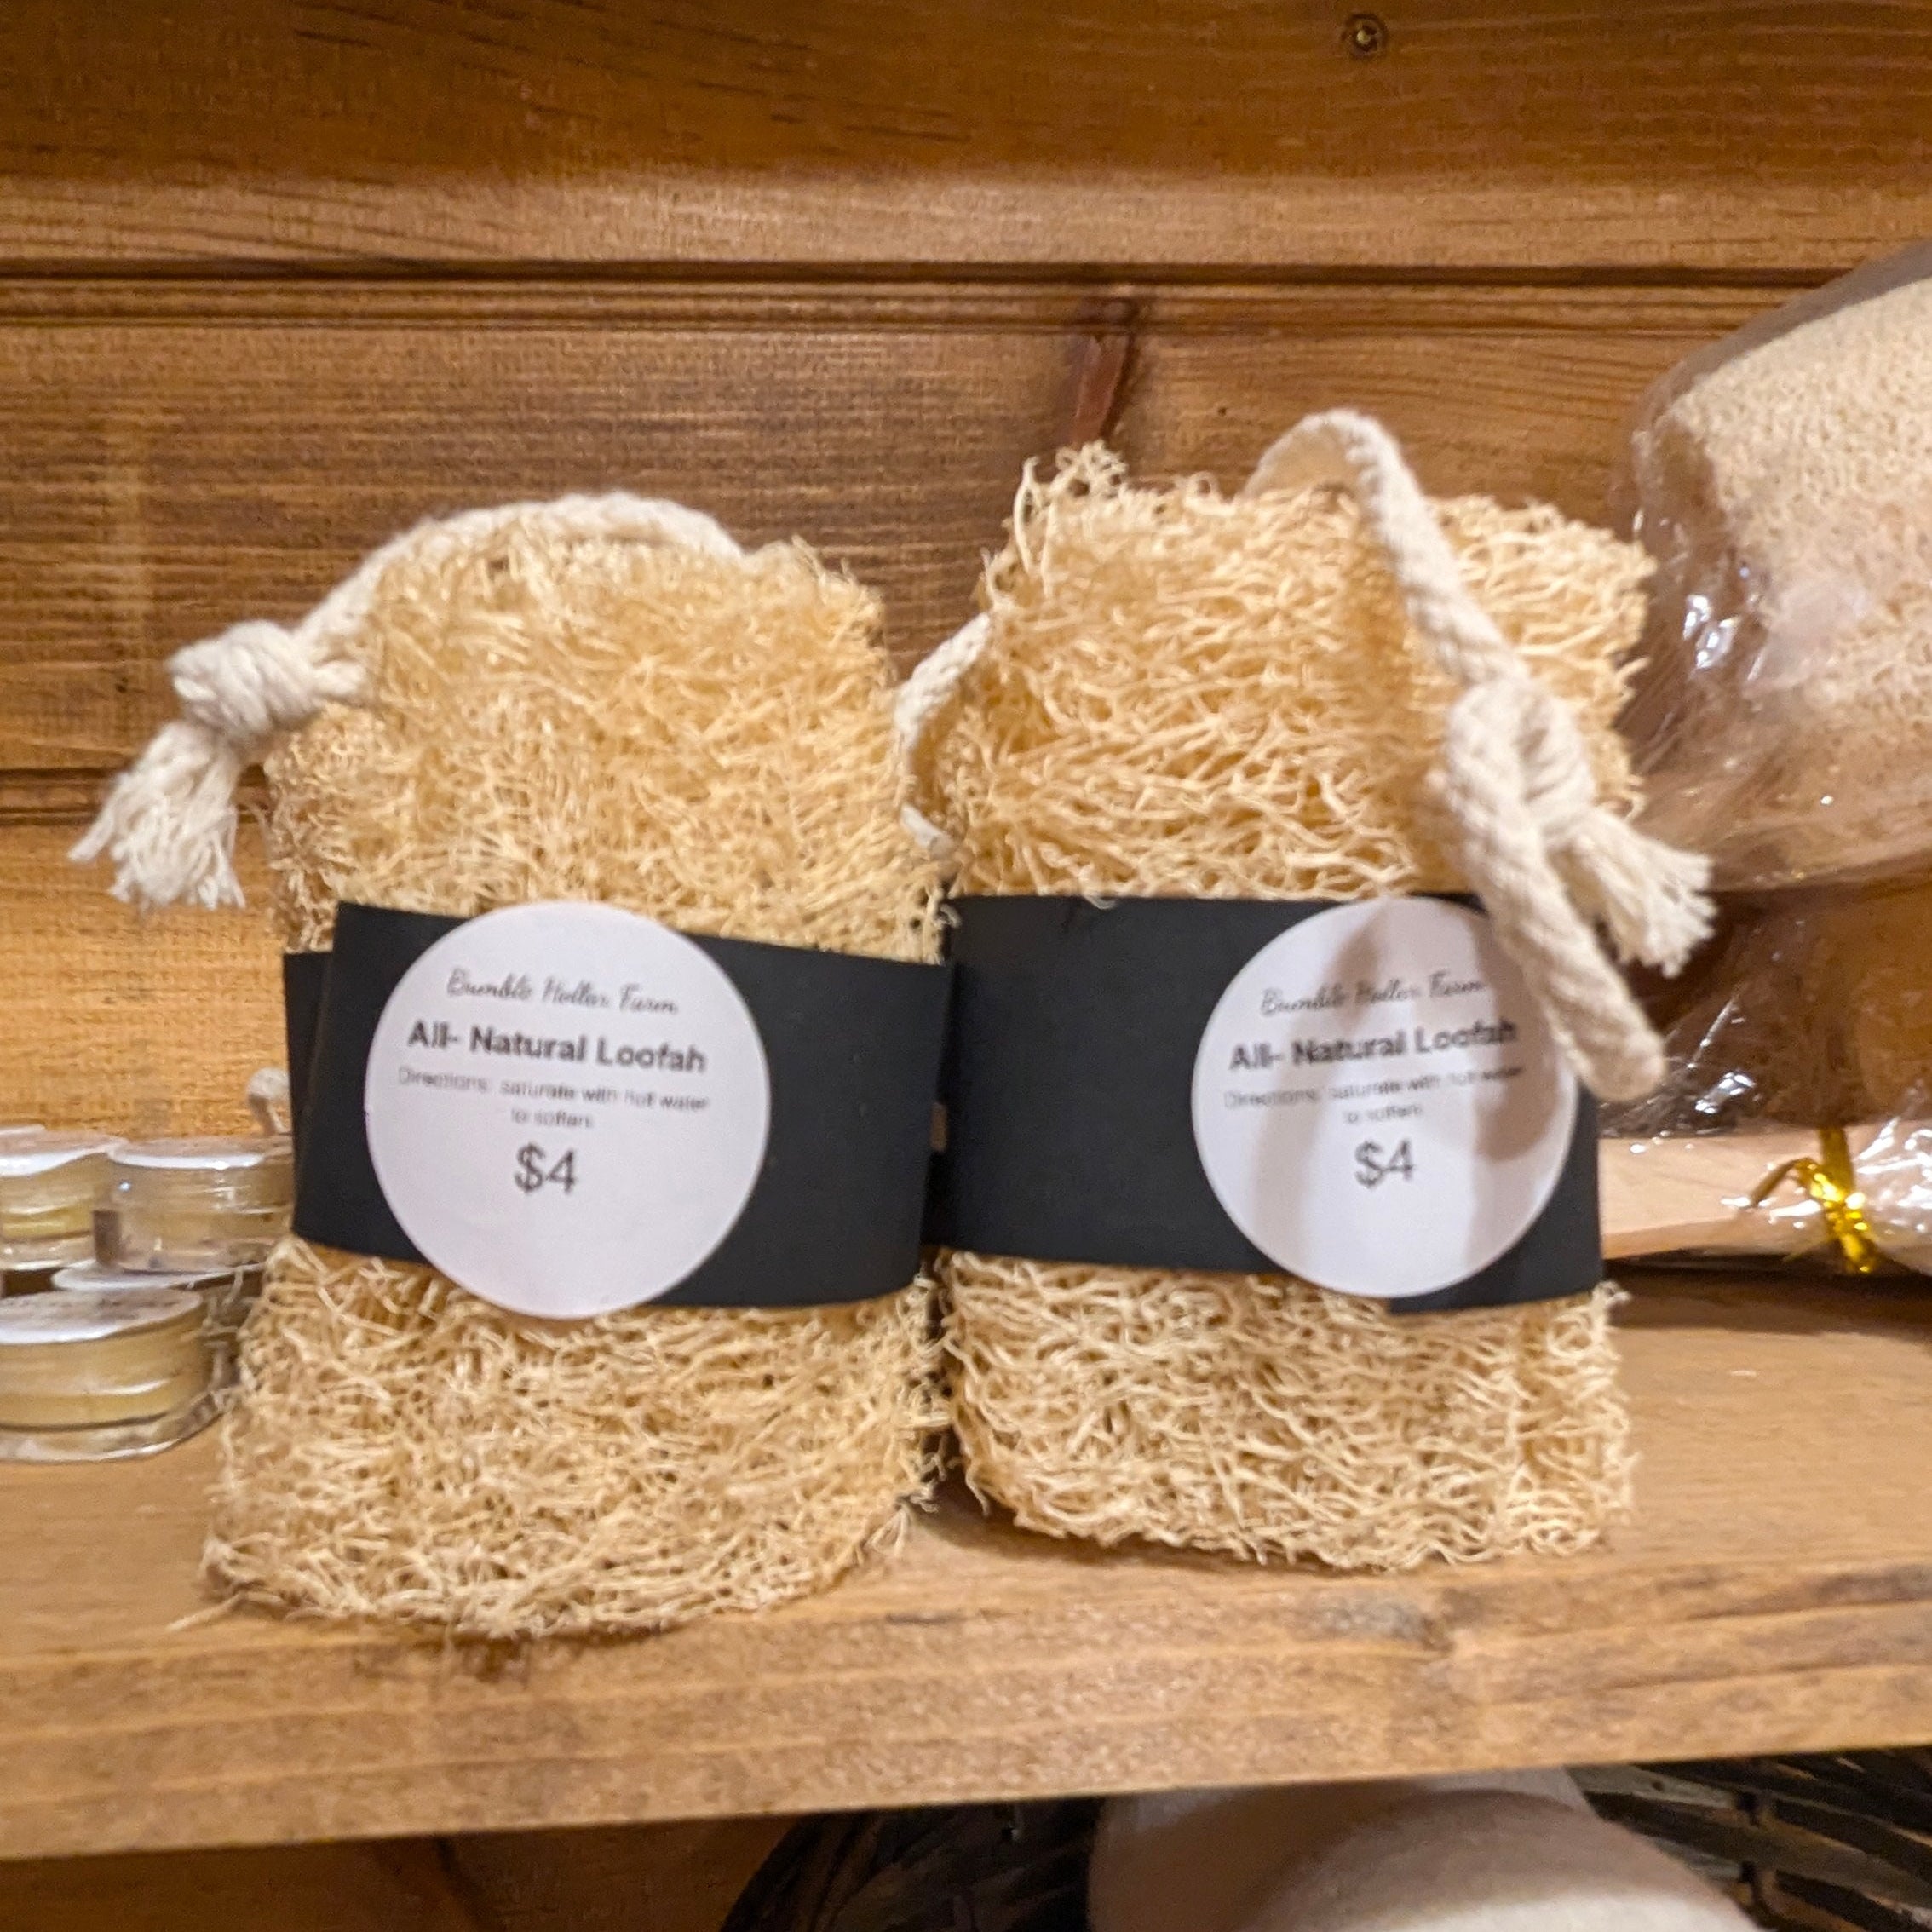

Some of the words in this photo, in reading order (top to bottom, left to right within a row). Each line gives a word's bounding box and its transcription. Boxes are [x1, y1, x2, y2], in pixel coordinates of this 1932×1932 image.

[618, 982, 679, 1015] Farm
[407, 1021, 458, 1050] All-
[469, 1026, 588, 1062] Natural
[598, 1036, 706, 1073] Loofah
[1228, 1042, 1280, 1071] All-
[1291, 1029, 1407, 1067] Natural
[1414, 1017, 1518, 1054] Loofah
[581, 1086, 618, 1104] with
[659, 1095, 710, 1113] water
[1407, 1073, 1440, 1091] with
[510, 1108, 529, 1124] to
[515, 1141, 578, 1194] $4
[1354, 1137, 1416, 1190] $4
